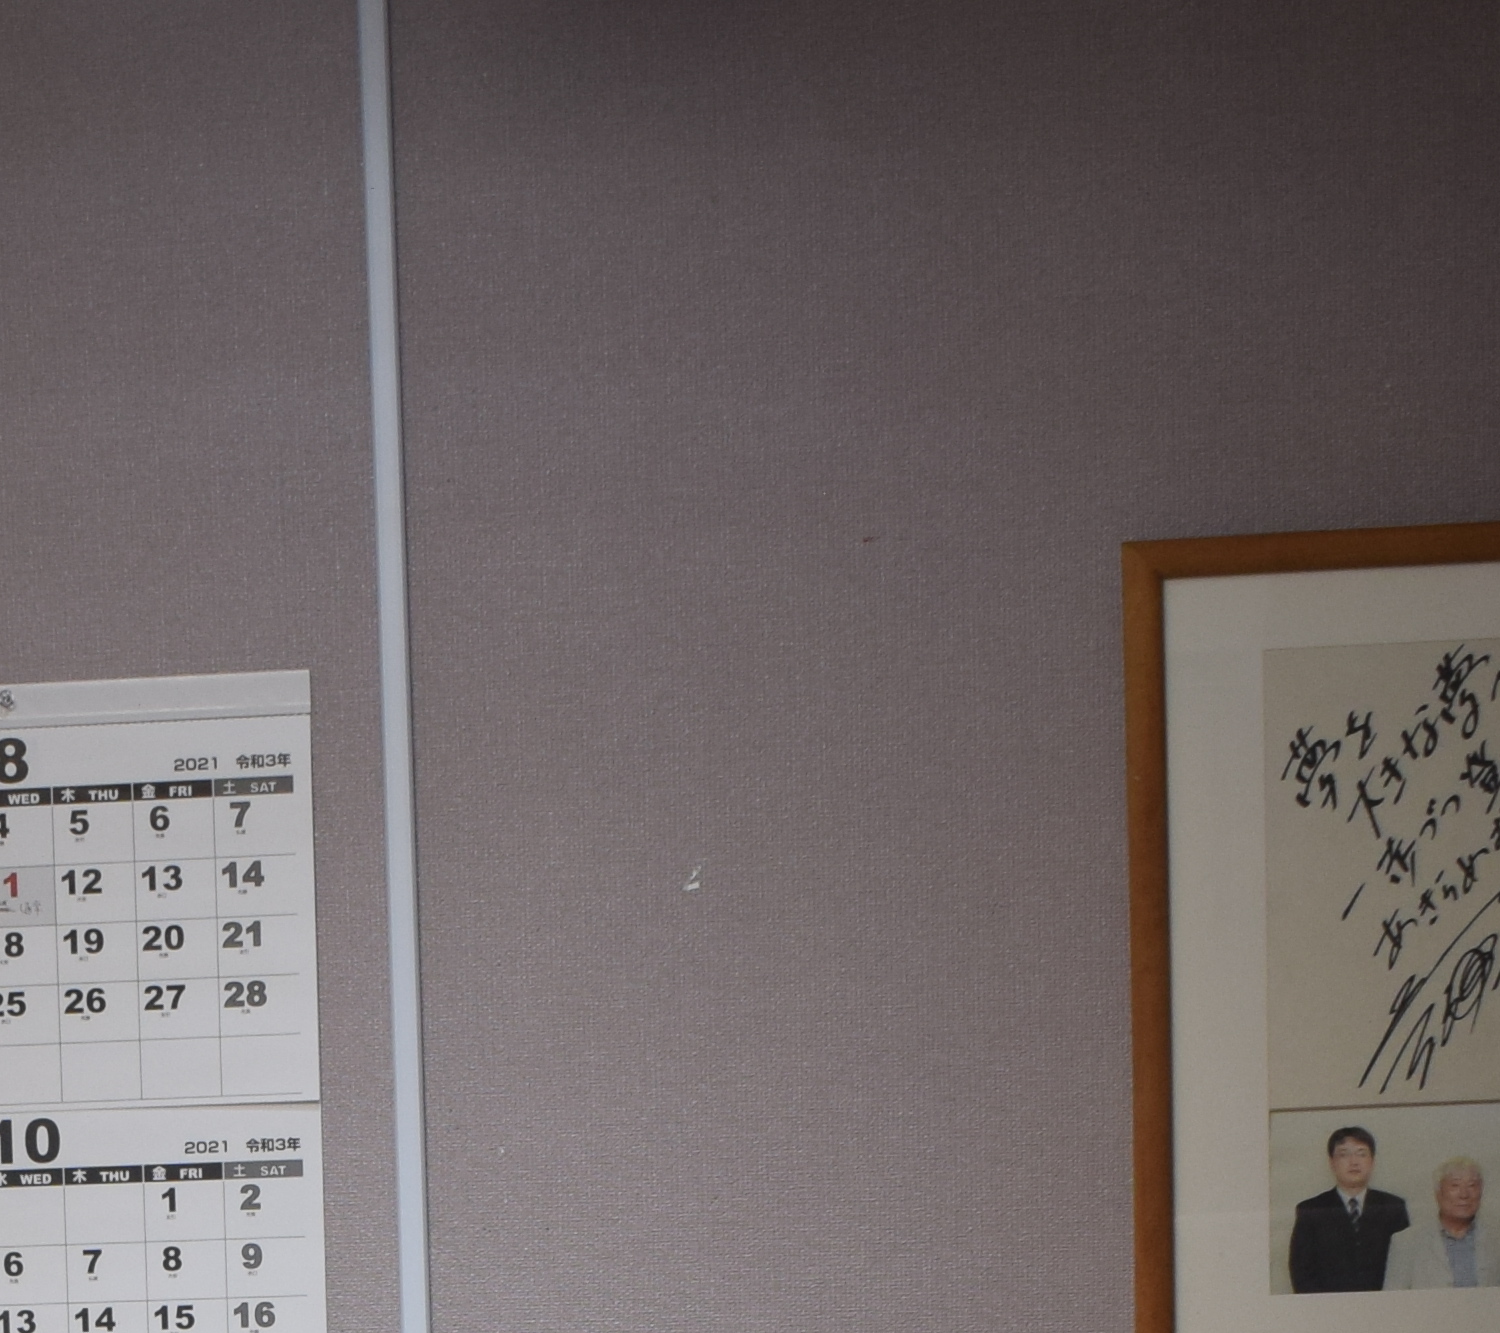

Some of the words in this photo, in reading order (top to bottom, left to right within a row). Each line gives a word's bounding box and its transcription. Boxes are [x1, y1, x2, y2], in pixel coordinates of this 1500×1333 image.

[174, 757, 218, 771] 2021
[236, 753, 291, 769] 令和3年
[8, 793, 39, 805] WED
[61, 788, 75, 802] 木
[89, 789, 118, 800] THU
[141, 784, 156, 798] 金
[169, 786, 192, 797] FRI
[223, 781, 236, 795] 土
[250, 782, 277, 792] SAT
[70, 810, 89, 835] 5
[150, 806, 169, 831] 6
[230, 802, 250, 827] 7
[62, 869, 102, 894] 12
[142, 865, 182, 891] 13
[222, 861, 264, 888] 14
[64, 929, 103, 954] 19
[143, 925, 184, 951] 20
[223, 921, 261, 948] 21
[65, 988, 106, 1014] 26
[145, 985, 185, 1010] 27
[224, 981, 267, 1007] 28
[185, 1140, 228, 1153] 2021
[246, 1137, 301, 1152] 令和3年
